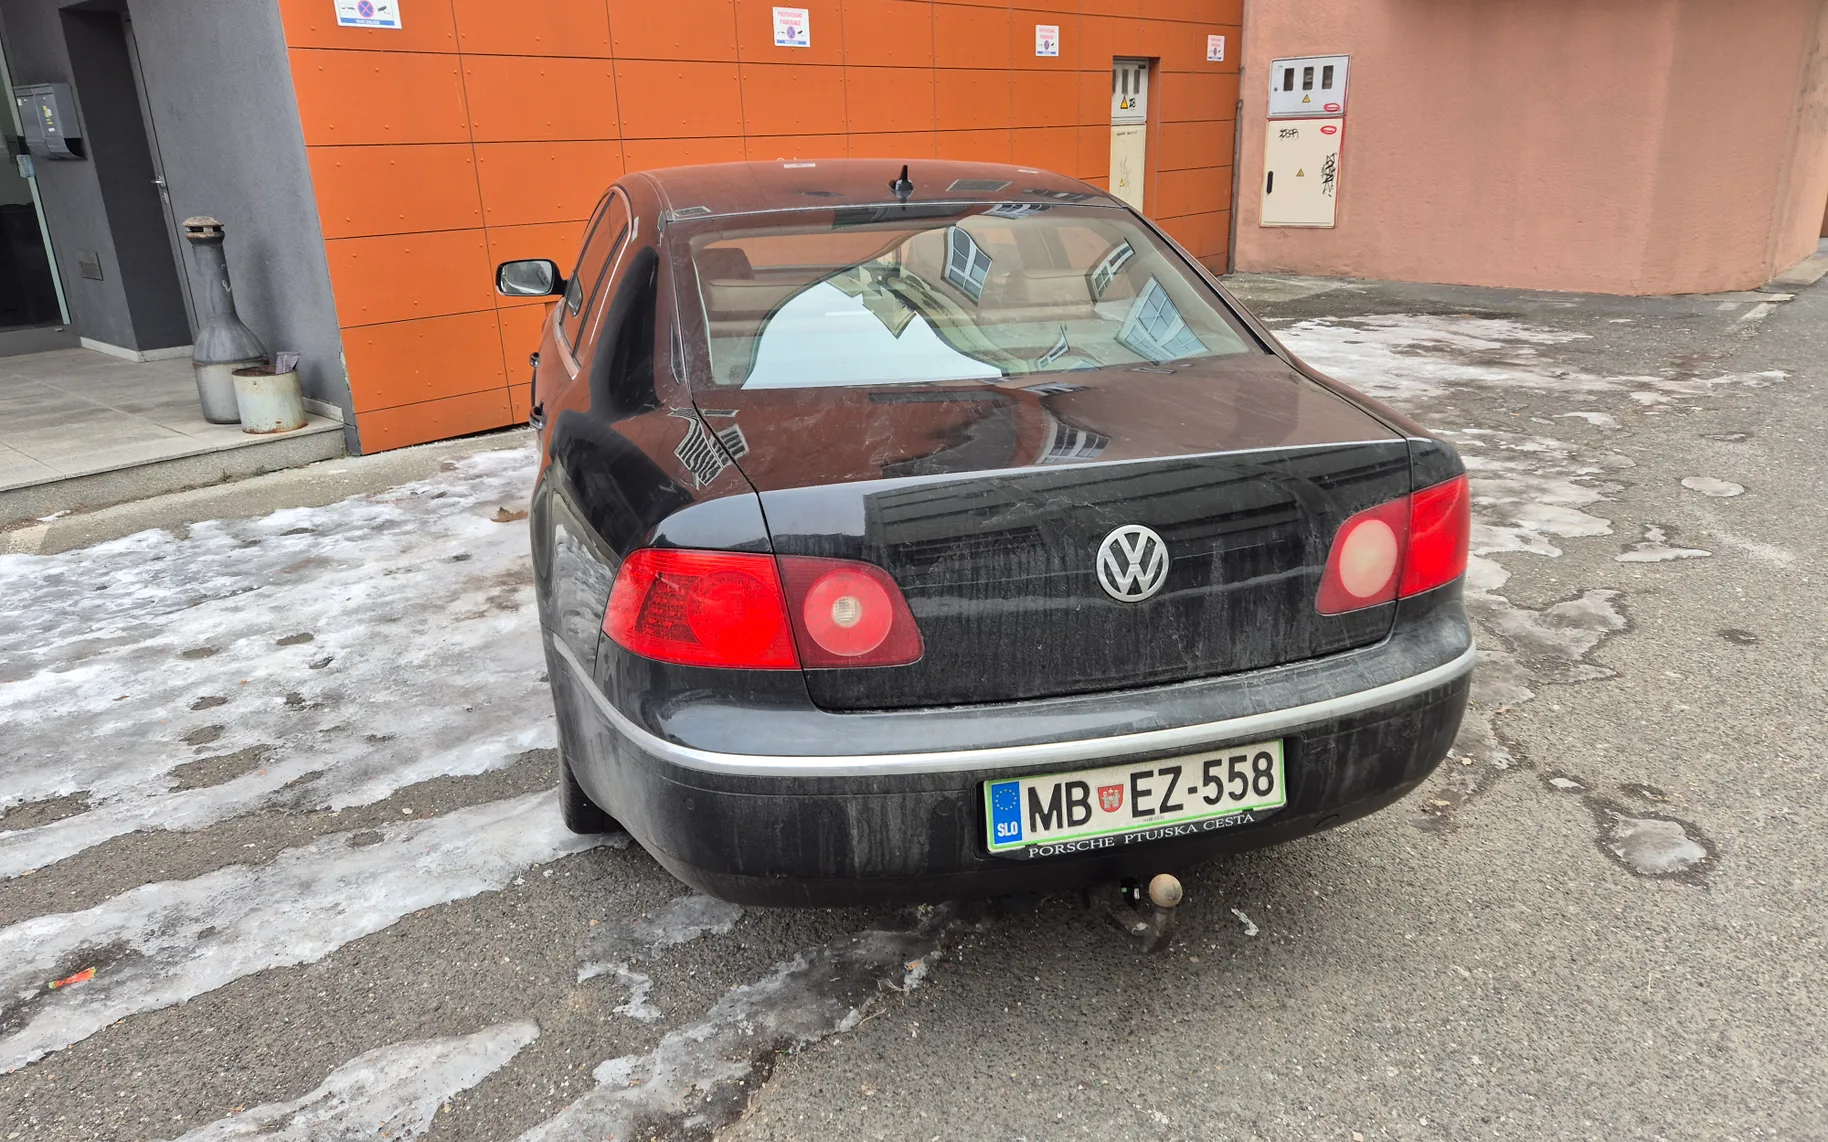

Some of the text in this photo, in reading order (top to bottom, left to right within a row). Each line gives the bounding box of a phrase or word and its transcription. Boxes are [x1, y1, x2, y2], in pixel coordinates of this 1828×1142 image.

[1096, 524, 1170, 603] VW
[1027, 750, 1275, 833] MB EZ-558
[997, 820, 1019, 837] SLO
[1028, 812, 1255, 858] PORSCHE PTUJSKA CESTA
